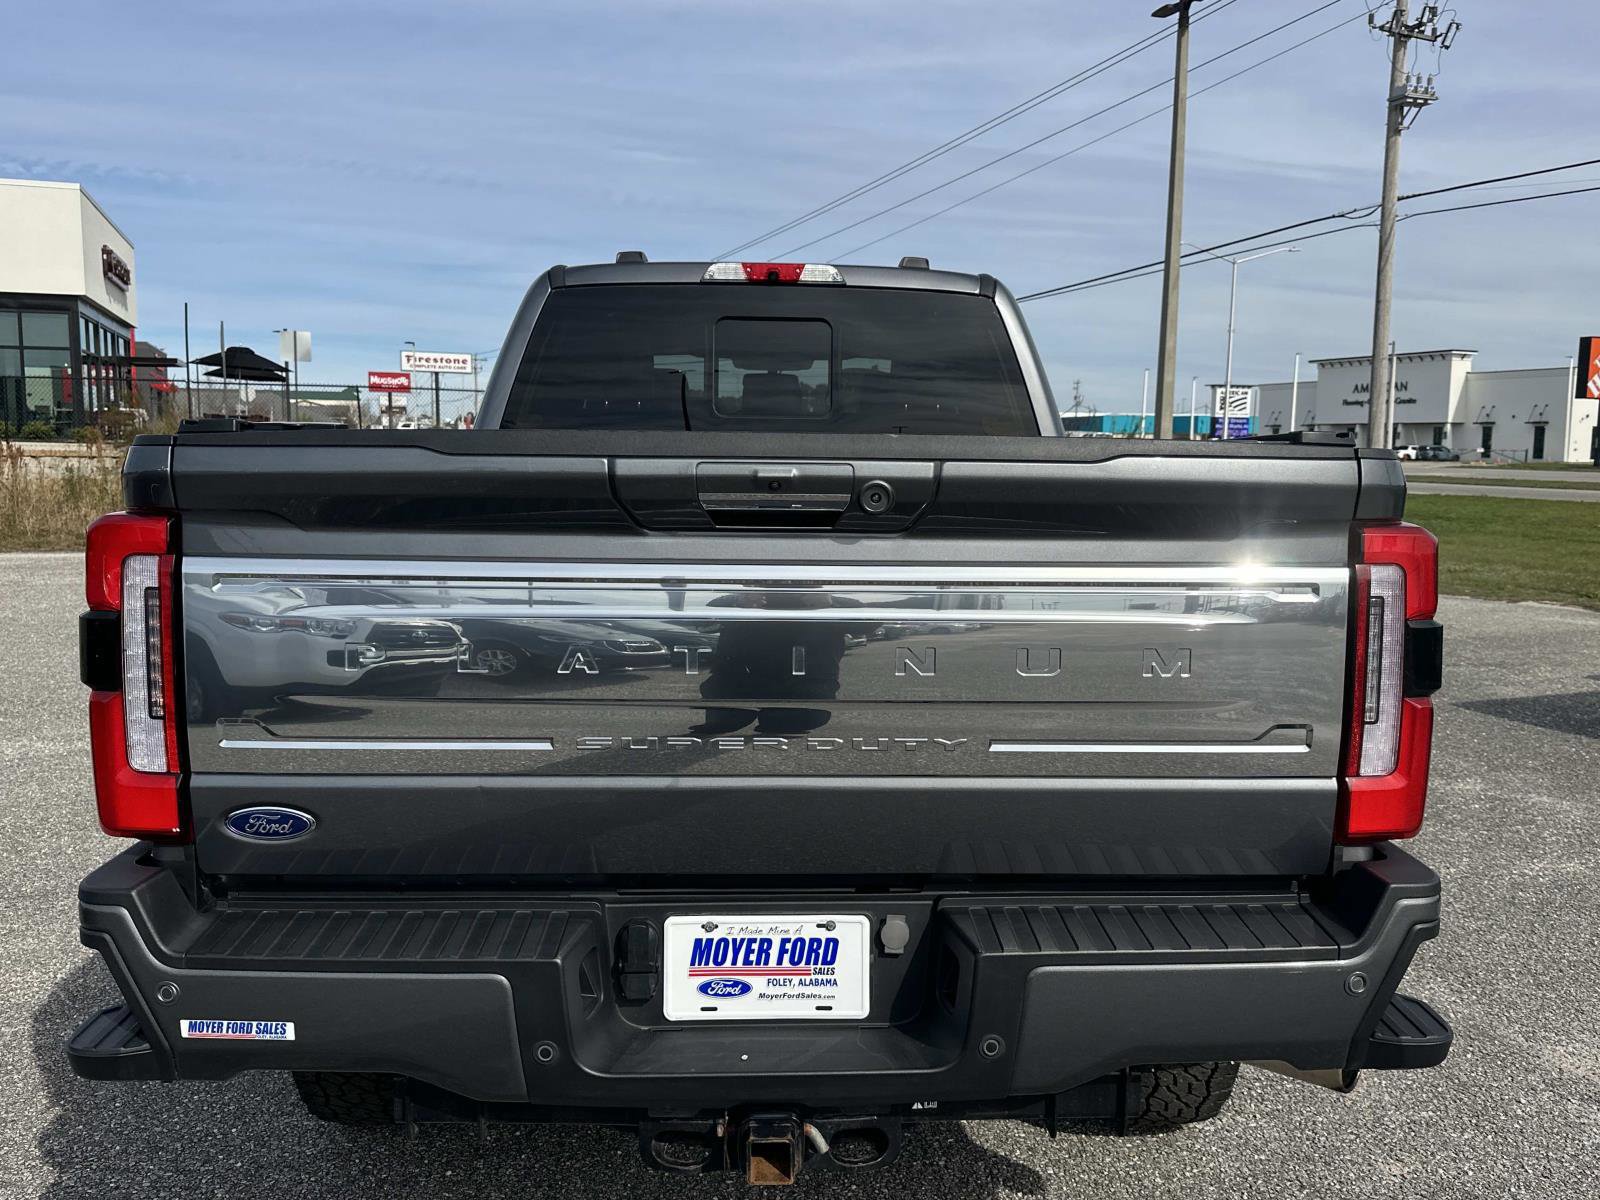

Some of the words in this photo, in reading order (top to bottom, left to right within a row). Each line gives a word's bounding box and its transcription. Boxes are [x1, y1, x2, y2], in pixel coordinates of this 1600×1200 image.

[405, 354, 468, 365] Firestone
[1352, 381, 1408, 394] AMAN
[344, 642, 1192, 678] PLATINUM
[576, 736, 789, 751] SUPER
[806, 737, 968, 752] DUTY
[244, 813, 294, 834] Ford
[738, 926, 764, 936] Made
[767, 926, 791, 936] Mine
[689, 936, 773, 968] MOYER
[776, 936, 840, 967] FORD
[812, 967, 836, 976] SALES
[707, 981, 742, 996] Ford
[767, 978, 796, 989] FOLEY,
[798, 978, 838, 988] ALABAMA
[758, 992, 836, 1001] MoyerFordSales.com
[187, 1020, 224, 1034] MOYER
[226, 1021, 254, 1035] FORD
[255, 1022, 287, 1035] SALES
